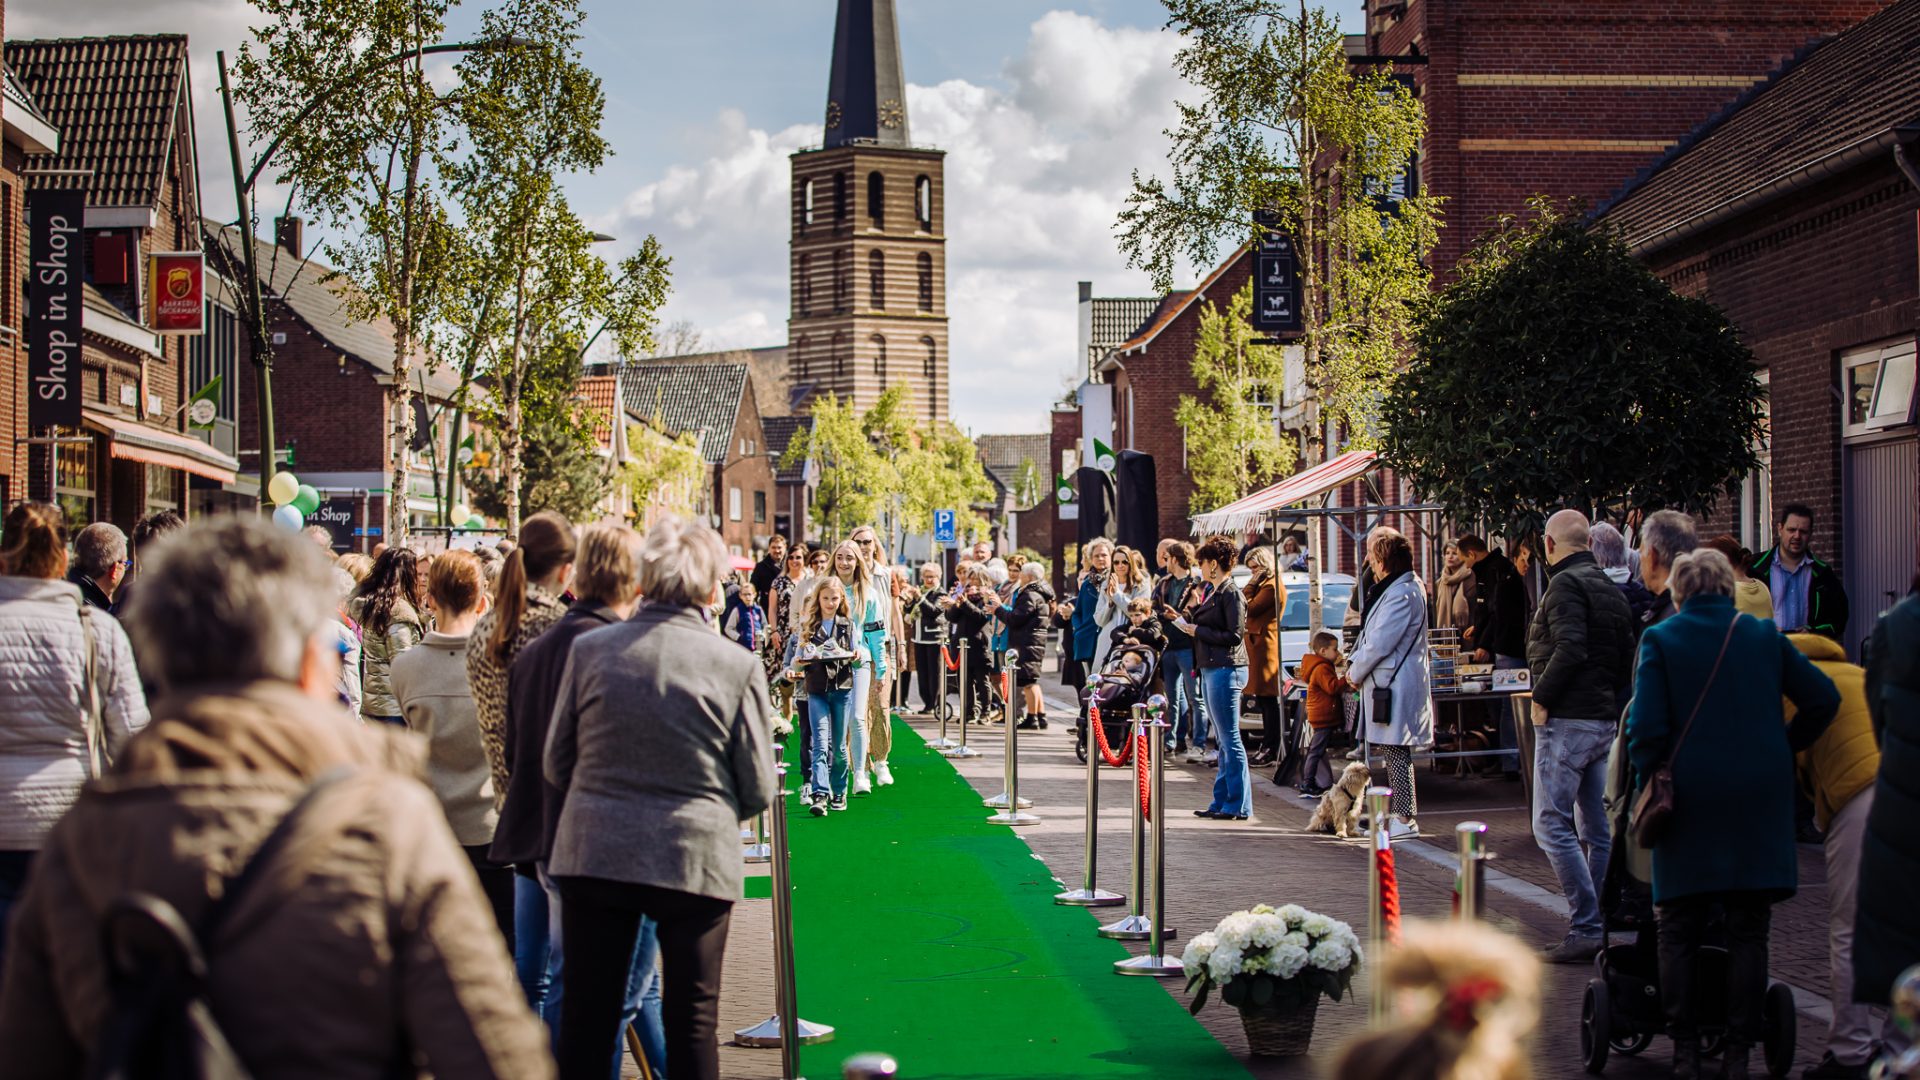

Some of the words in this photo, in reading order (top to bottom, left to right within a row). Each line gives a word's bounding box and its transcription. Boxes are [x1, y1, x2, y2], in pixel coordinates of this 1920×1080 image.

[36, 215, 78, 286] Shop
[41, 293, 67, 321] in
[36, 329, 77, 400] Shop
[321, 506, 351, 526] Shop
[938, 511, 951, 528] P
